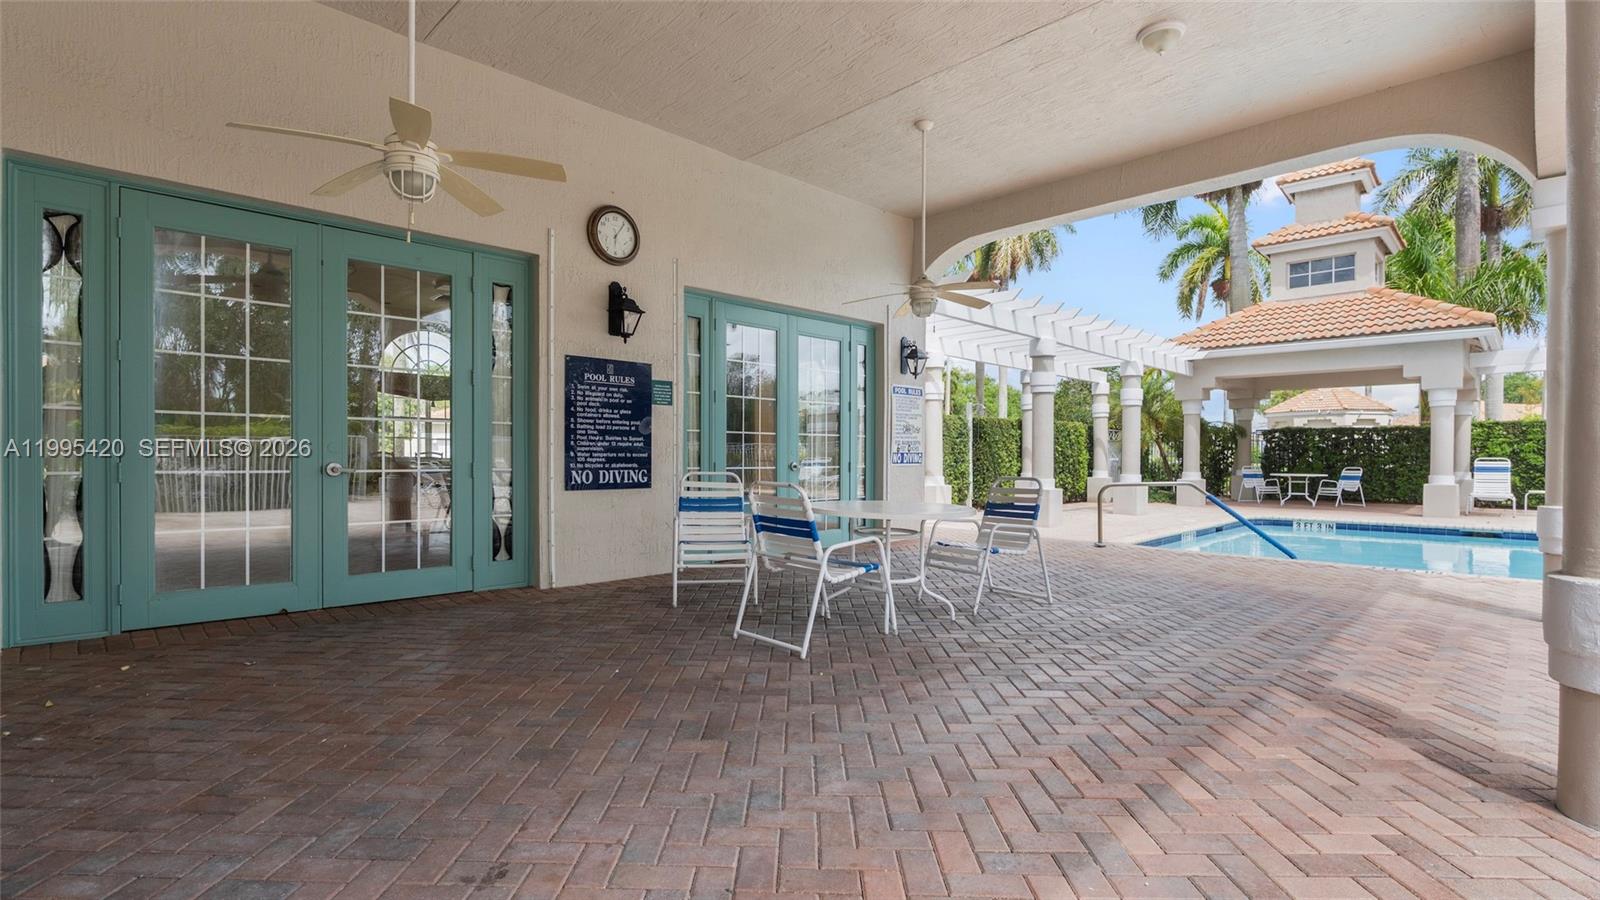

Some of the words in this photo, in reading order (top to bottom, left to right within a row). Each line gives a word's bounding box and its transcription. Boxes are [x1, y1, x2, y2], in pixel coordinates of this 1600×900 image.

[584, 373, 606, 381] POOL
[908, 388, 921, 396] RULES
[893, 453, 901, 463] NO
[903, 453, 922, 463] DIVING
[571, 470, 593, 484] NO
[599, 470, 648, 483] DIVING
